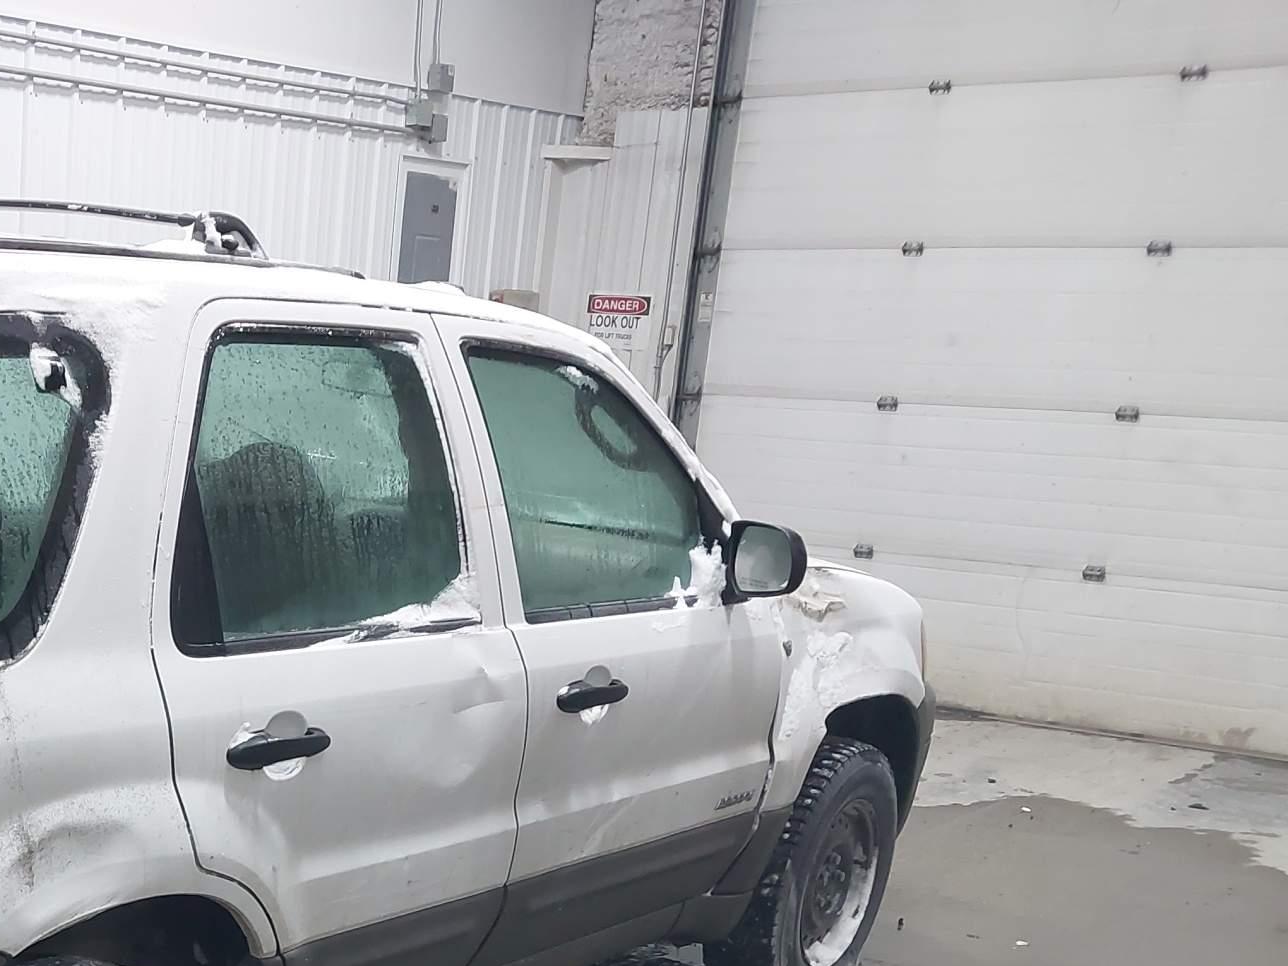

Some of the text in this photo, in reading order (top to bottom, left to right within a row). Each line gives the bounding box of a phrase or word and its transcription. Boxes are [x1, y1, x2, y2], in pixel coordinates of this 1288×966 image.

[594, 299, 640, 312] DANGER
[590, 315, 642, 329] LOOK OUT
